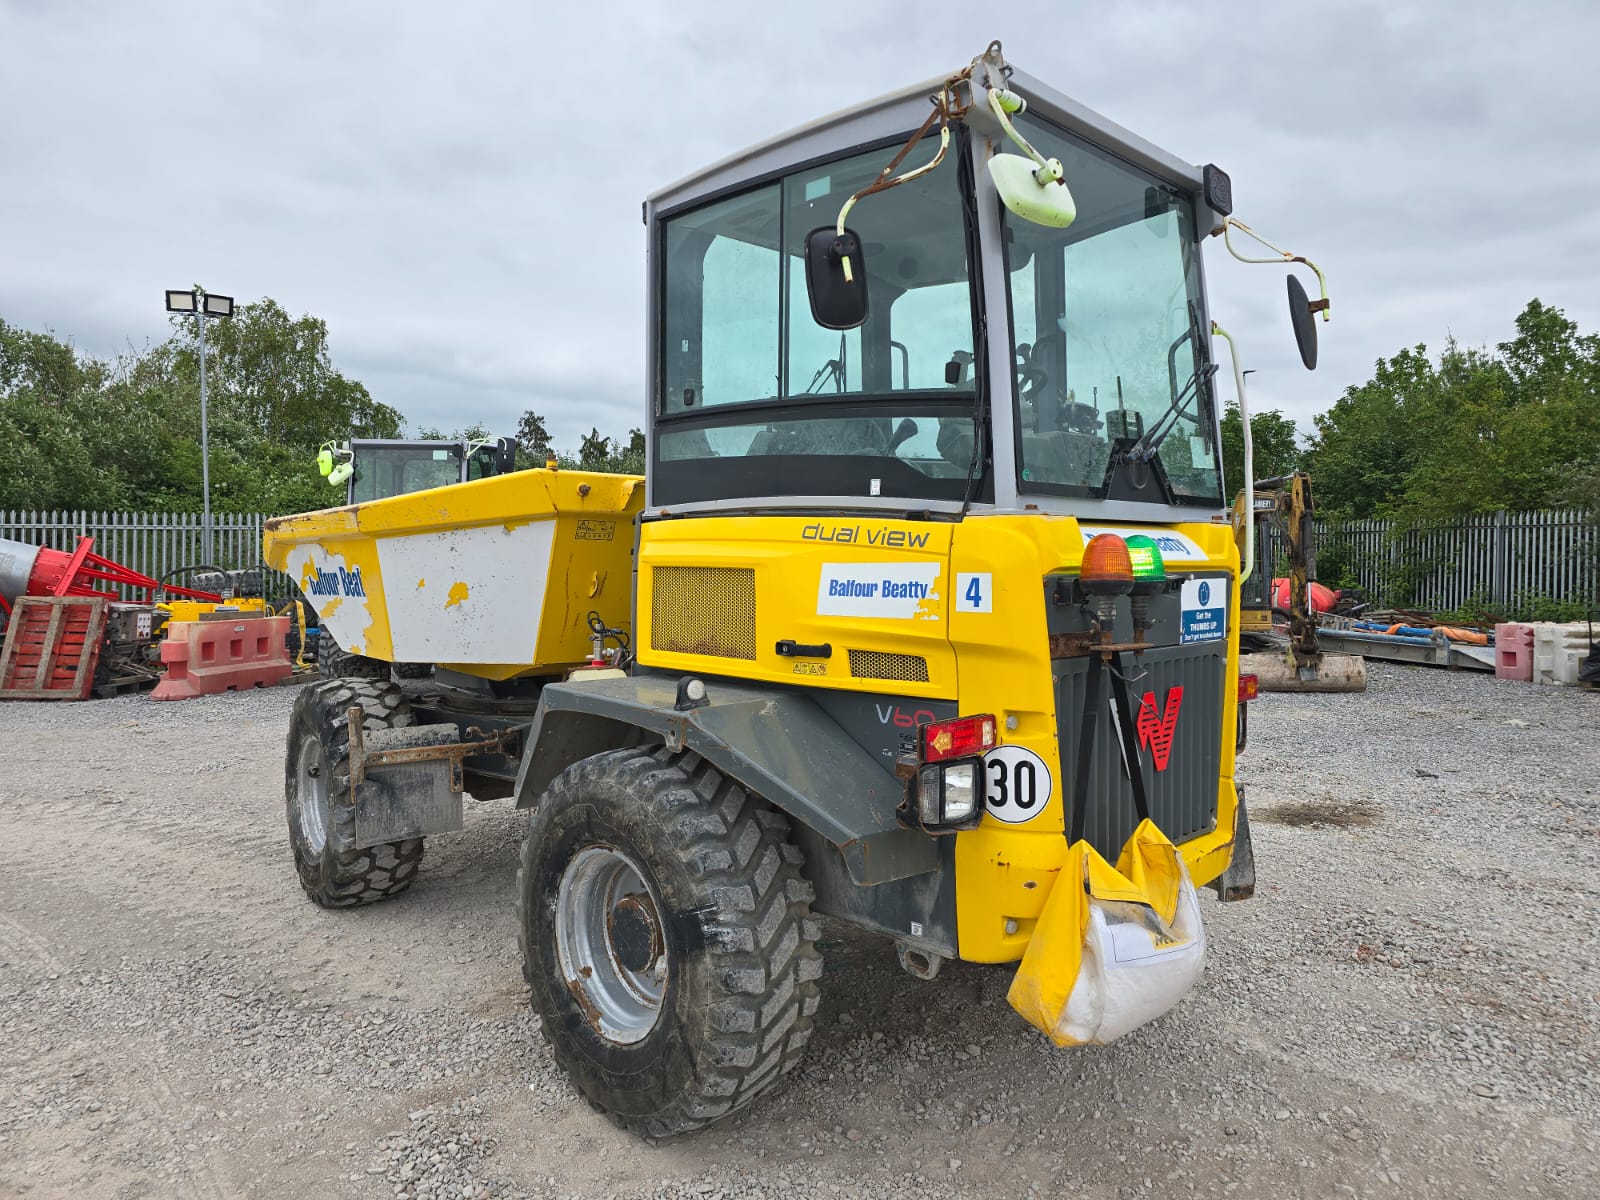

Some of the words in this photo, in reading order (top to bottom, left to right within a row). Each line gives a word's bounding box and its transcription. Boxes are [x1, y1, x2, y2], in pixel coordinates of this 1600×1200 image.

[801, 523, 860, 544] dual
[866, 526, 930, 548] view
[828, 579, 878, 598] Balfour
[881, 580, 928, 599] Beatty
[965, 577, 982, 608] 4
[1190, 622, 1210, 632] THUMBS
[1210, 621, 1217, 630] UP
[987, 758, 1037, 810] 30
